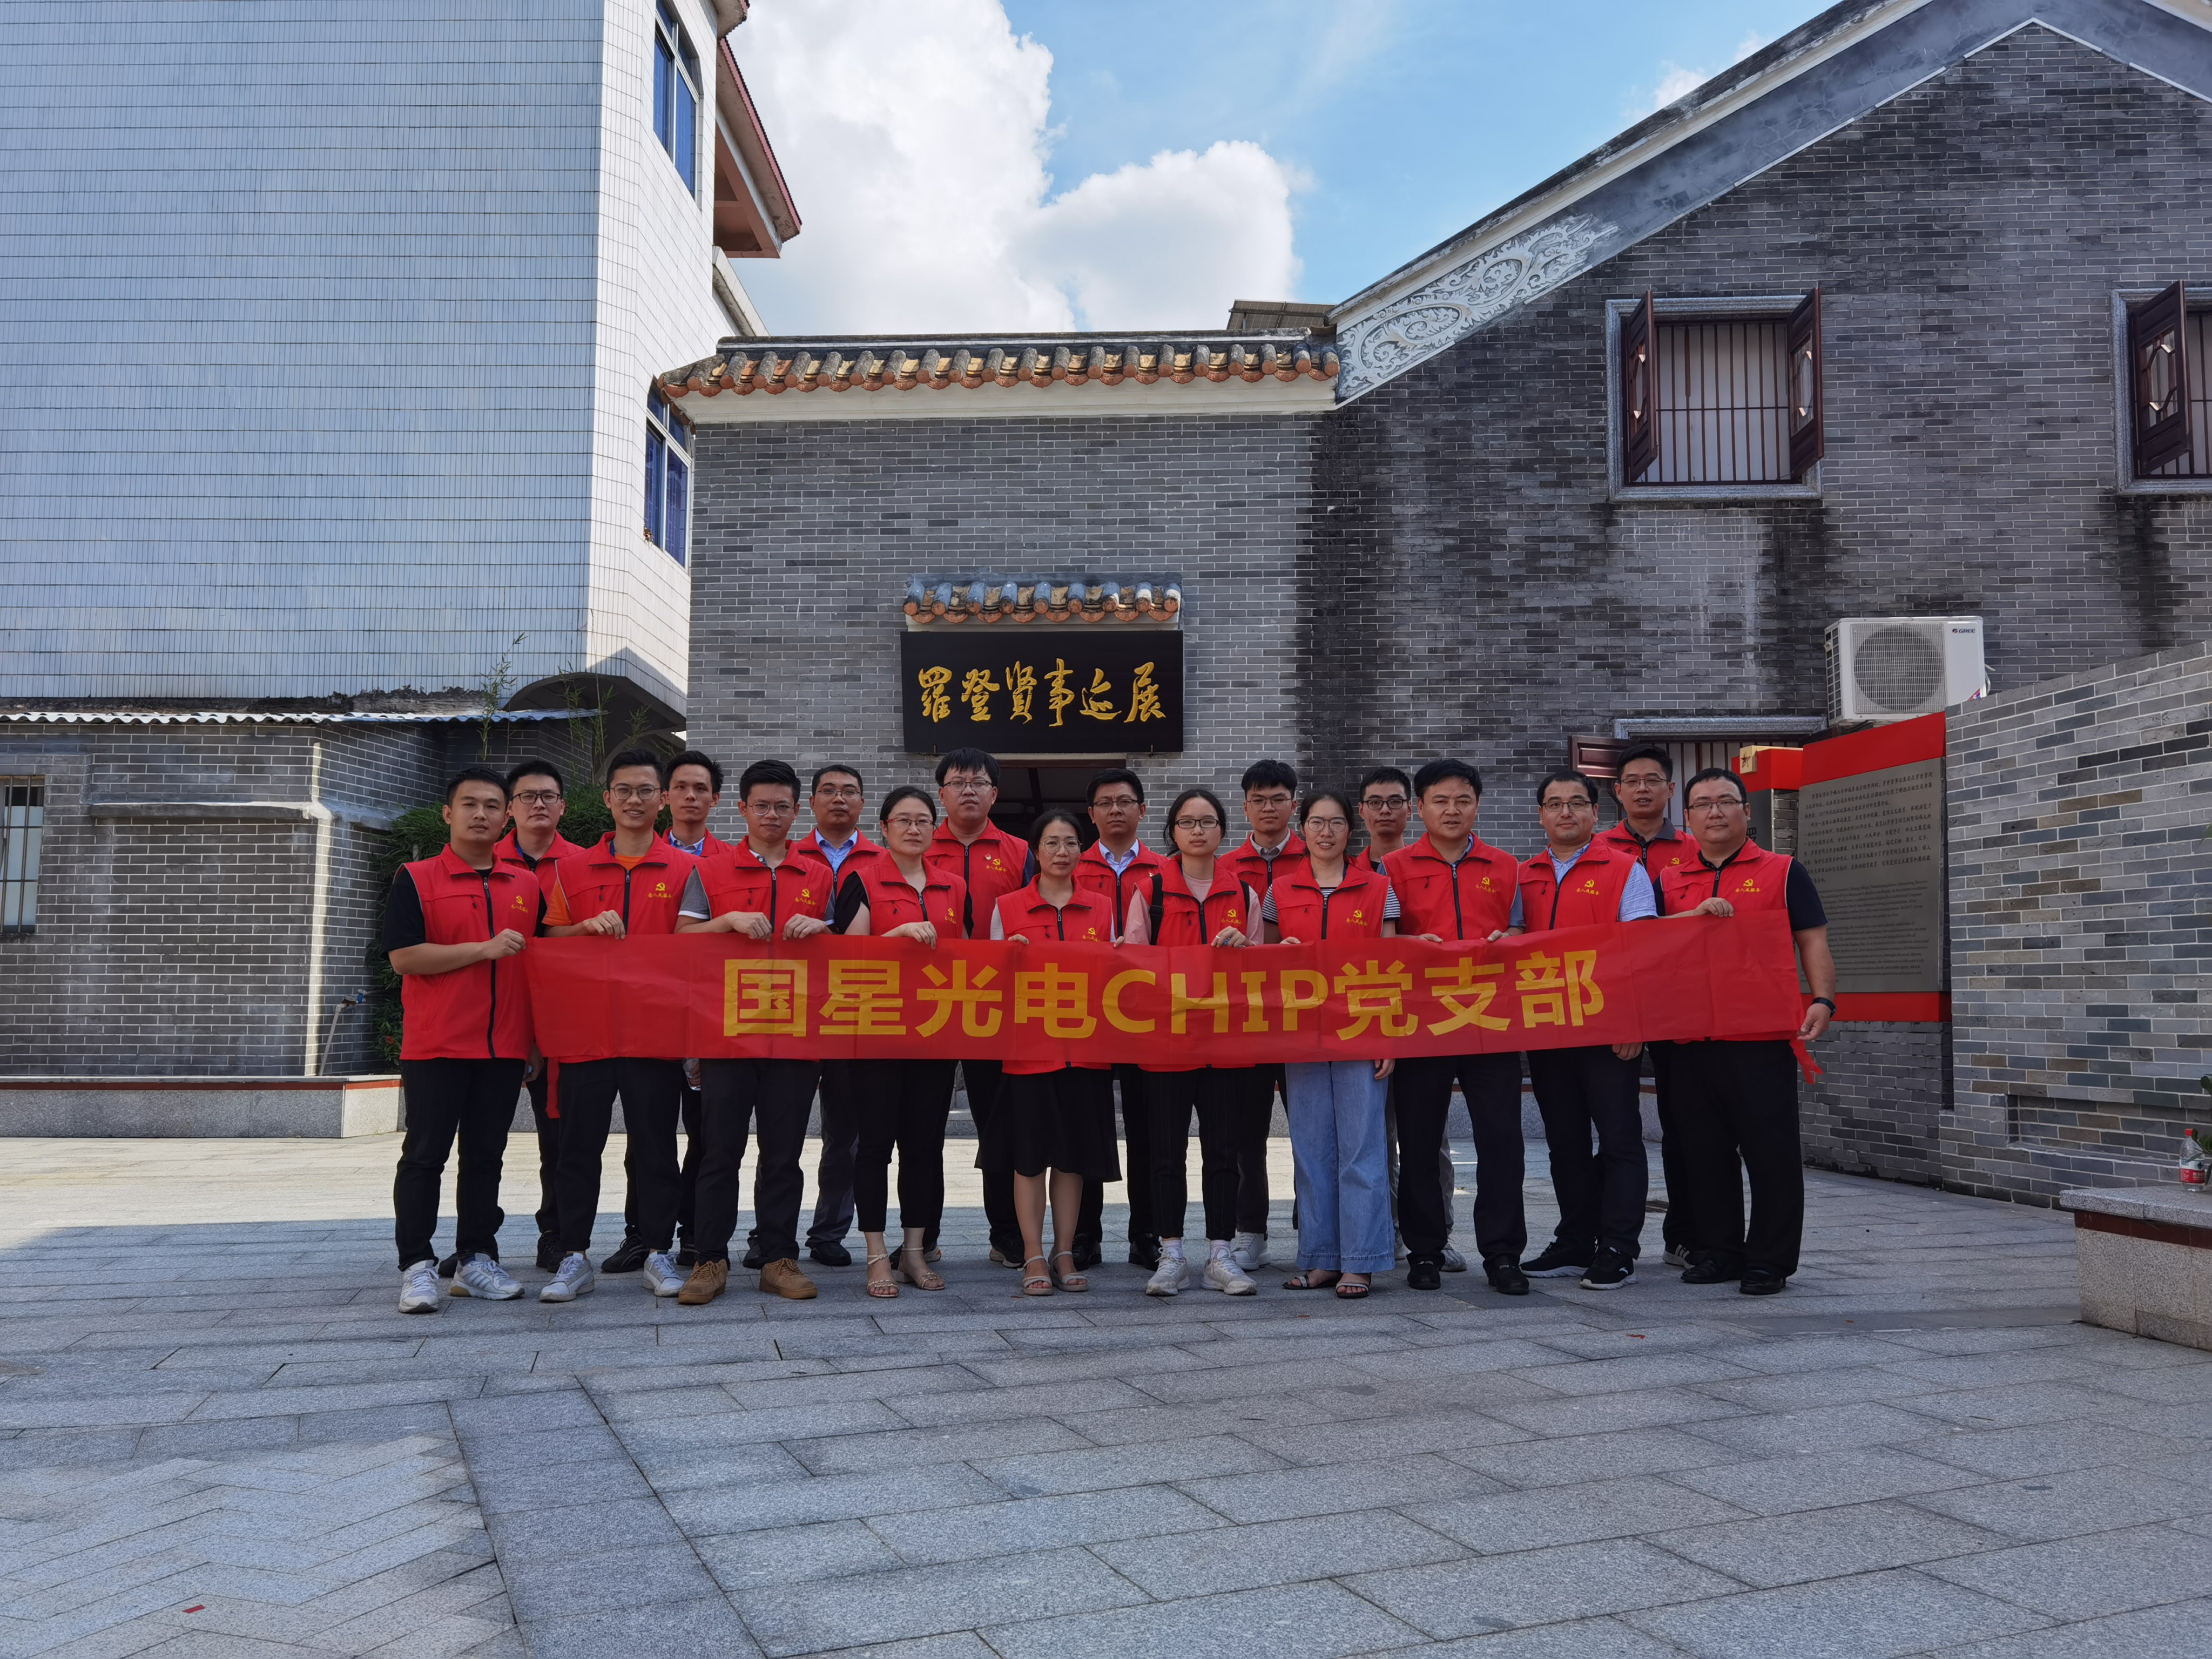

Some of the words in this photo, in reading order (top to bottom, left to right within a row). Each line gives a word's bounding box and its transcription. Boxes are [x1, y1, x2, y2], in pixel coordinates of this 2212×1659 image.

[723, 949, 1604, 1041] 国星光电CHIP党支部
